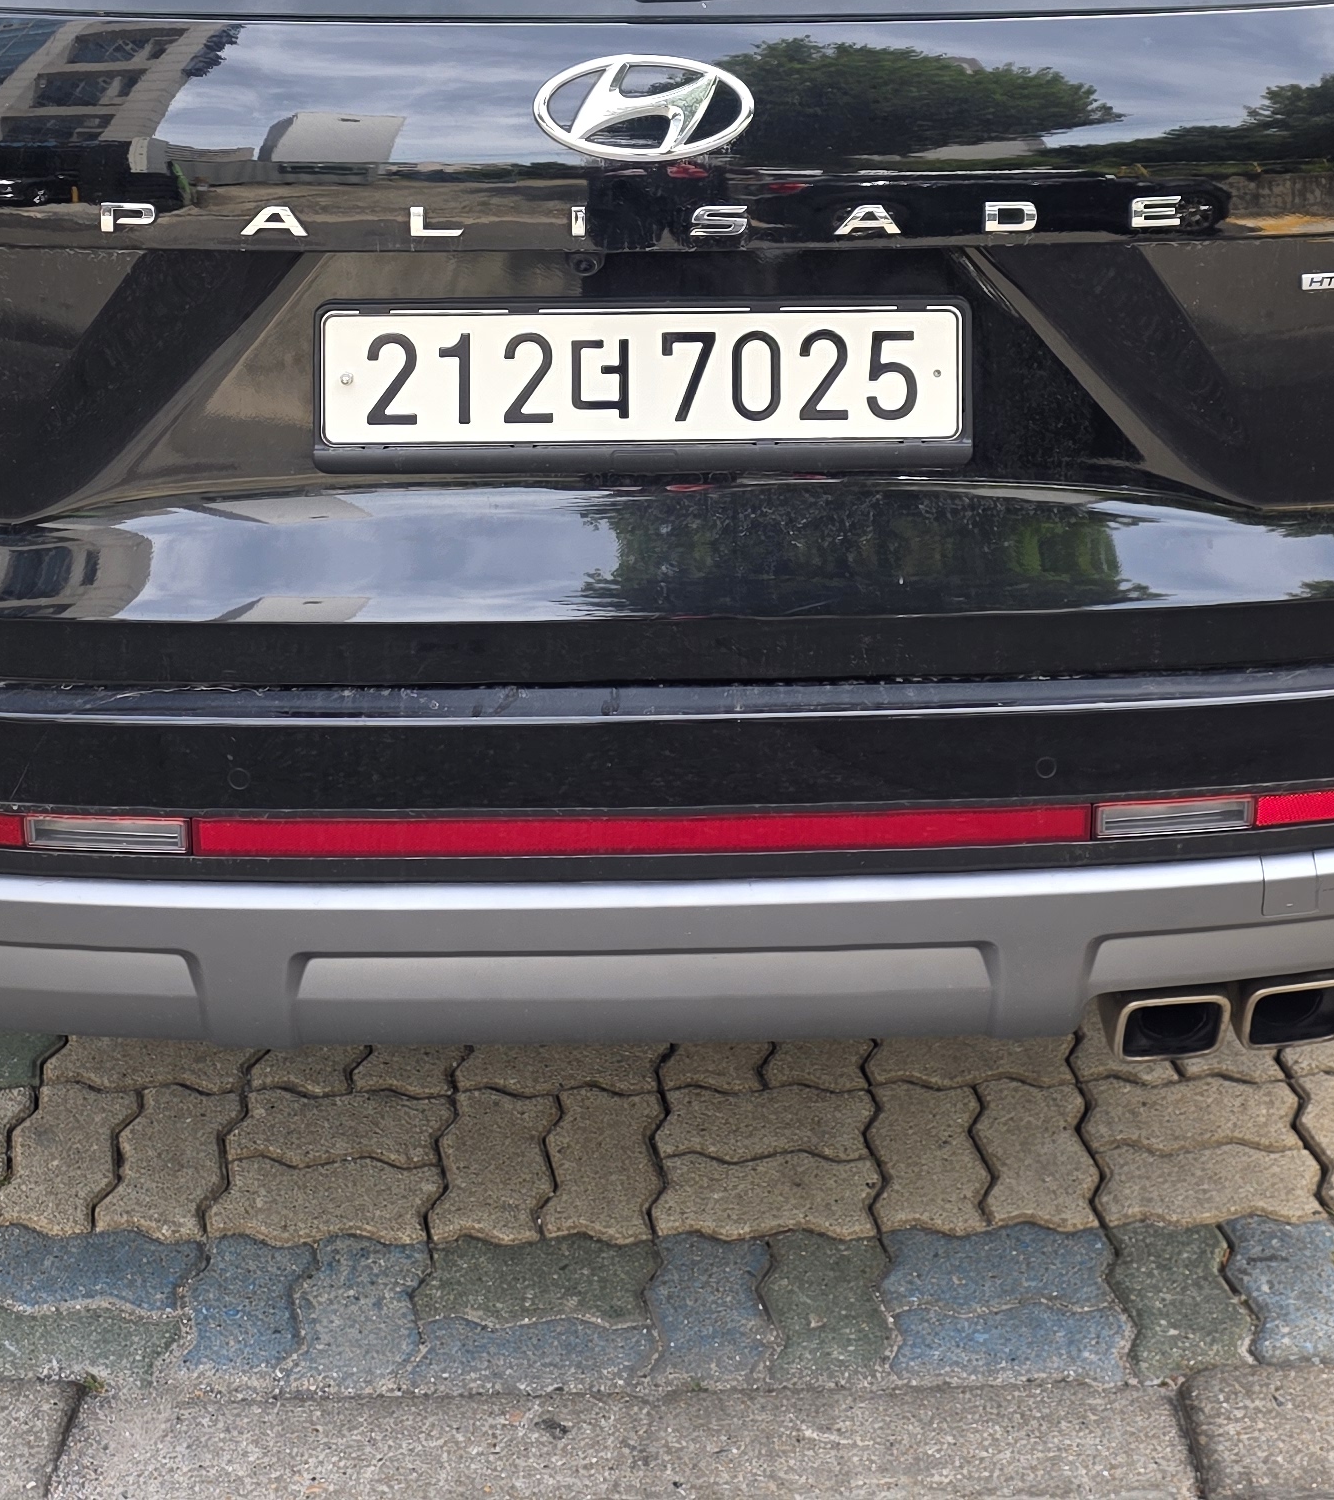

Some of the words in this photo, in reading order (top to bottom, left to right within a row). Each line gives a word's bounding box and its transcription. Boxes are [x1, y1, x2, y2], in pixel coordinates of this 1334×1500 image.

[100, 195, 1182, 238] PALISADE
[366, 331, 630, 426] 212더
[661, 328, 919, 423] 7025
